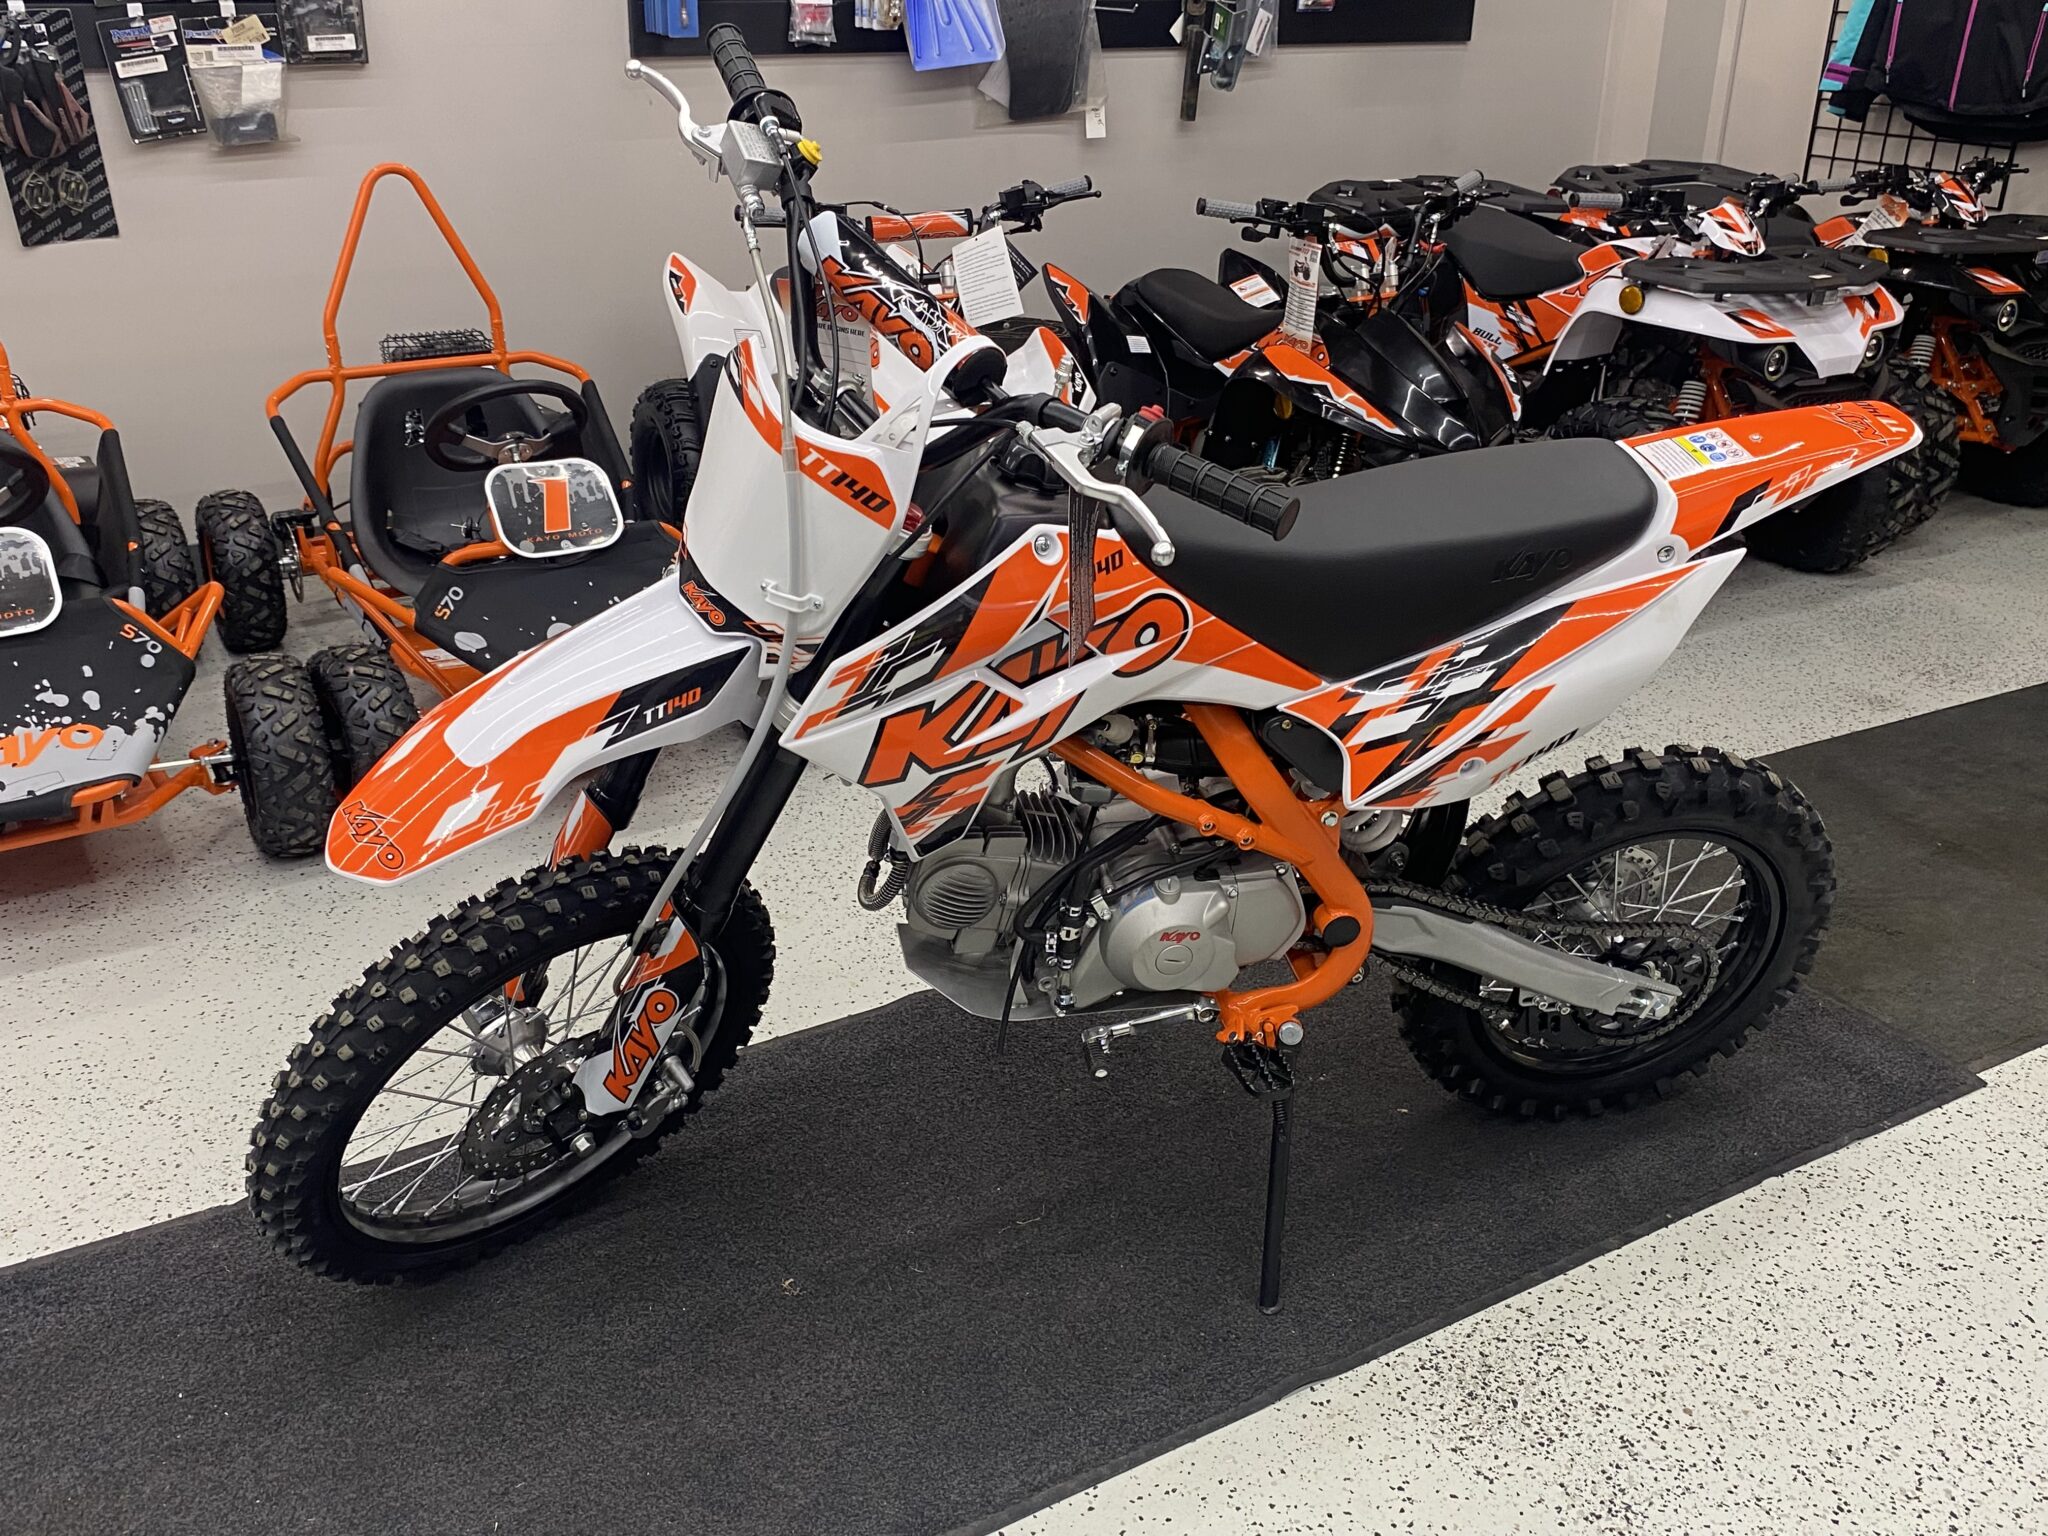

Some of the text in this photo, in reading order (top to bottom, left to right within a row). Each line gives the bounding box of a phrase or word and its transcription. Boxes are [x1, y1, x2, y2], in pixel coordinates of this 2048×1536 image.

[821, 254, 935, 373] KAYO
[1472, 326, 1502, 346] BULL
[801, 447, 891, 513] TT140
[528, 476, 572, 533] 1
[526, 527, 603, 543] KAYO MOTO
[434, 585, 464, 621] S70
[681, 579, 726, 627] KAYO
[120, 623, 163, 655] S70
[643, 686, 702, 726] TT140
[340, 799, 406, 872] KAYO
[602, 987, 679, 1104] KAYO
